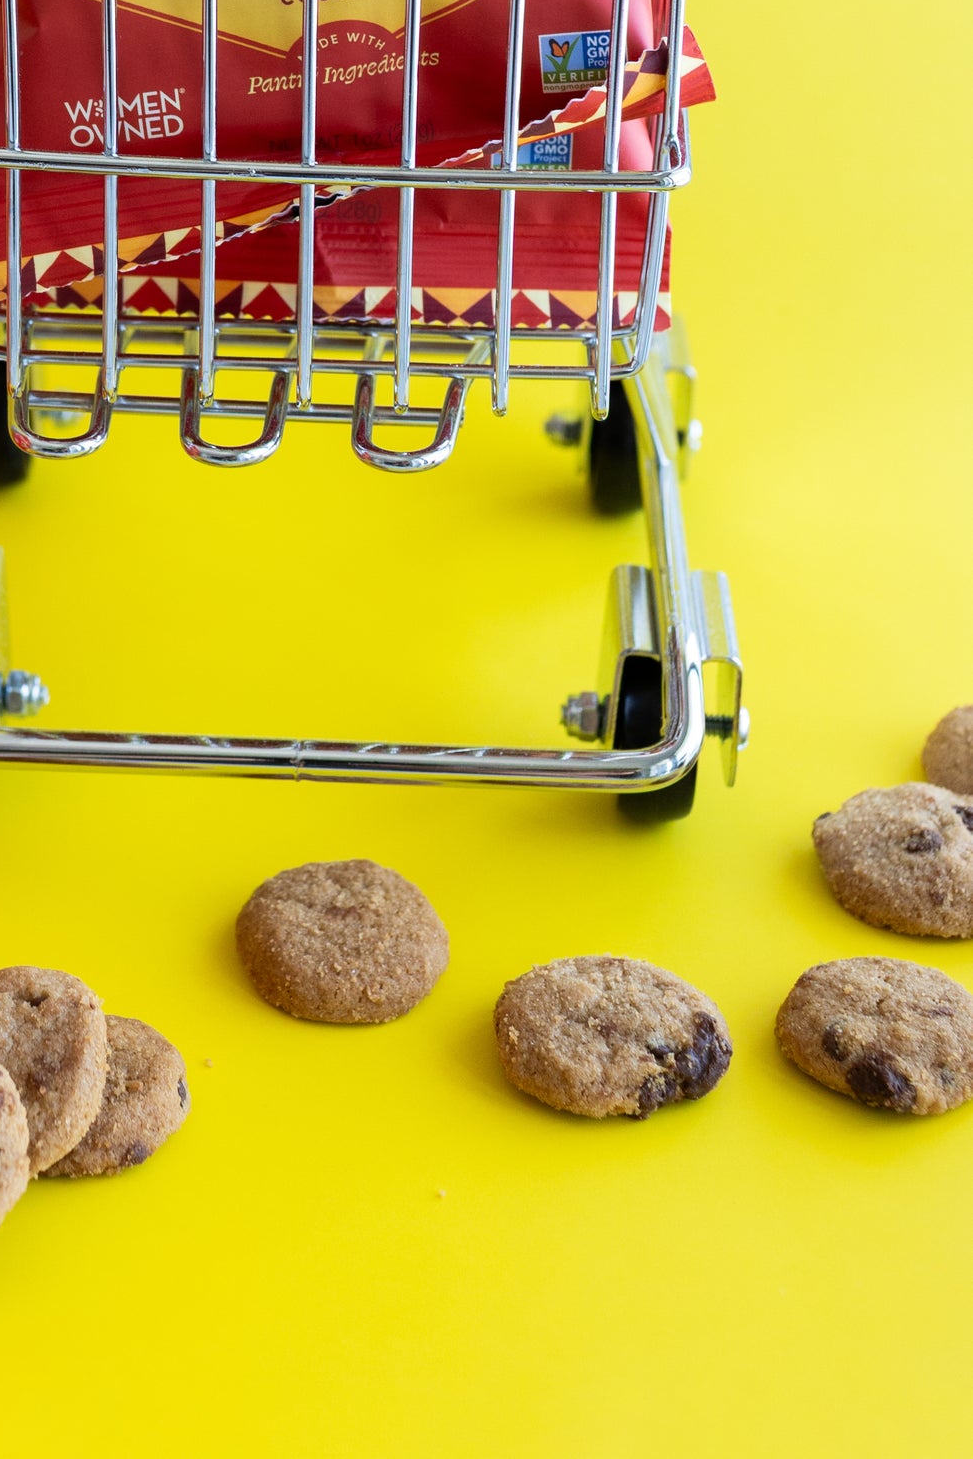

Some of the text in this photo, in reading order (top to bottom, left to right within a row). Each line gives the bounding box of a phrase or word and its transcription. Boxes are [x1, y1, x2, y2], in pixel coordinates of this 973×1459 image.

[347, 32, 385, 50] WITH
[587, 35, 609, 46] NO
[587, 47, 609, 58] GM
[588, 59, 608, 68] Proj
[248, 50, 439, 94] Pantr Ingrediets
[548, 70, 607, 82] VERIFI
[534, 145, 568, 154] GMO
[534, 153, 567, 163] Project
